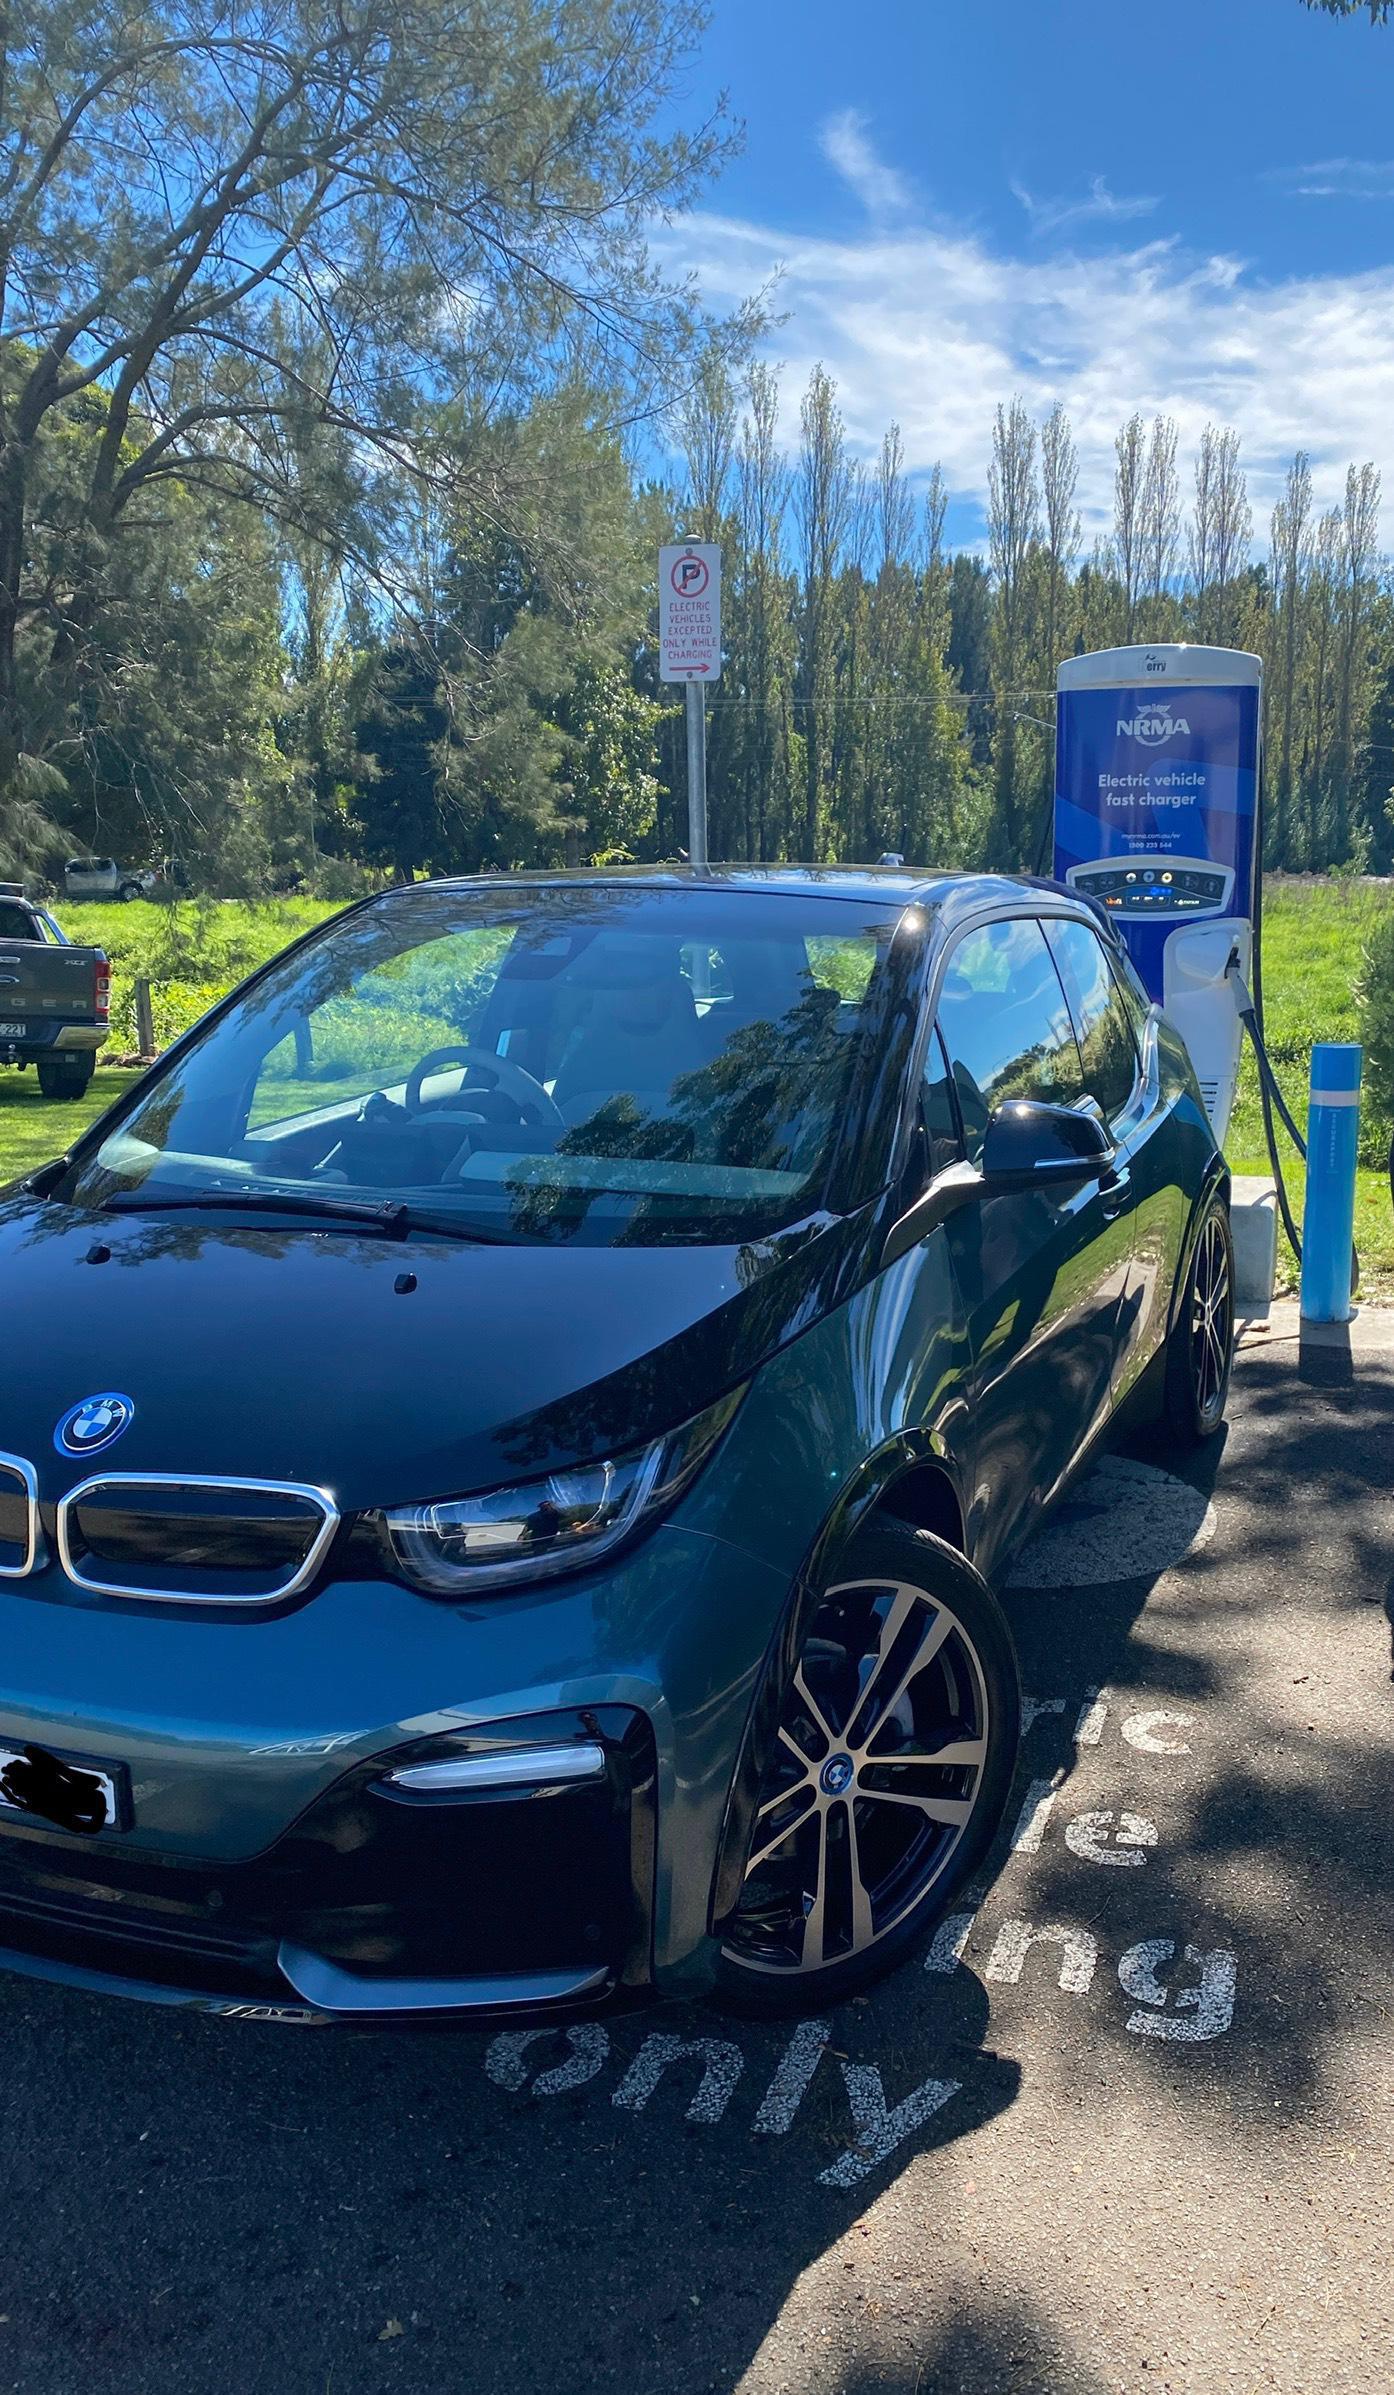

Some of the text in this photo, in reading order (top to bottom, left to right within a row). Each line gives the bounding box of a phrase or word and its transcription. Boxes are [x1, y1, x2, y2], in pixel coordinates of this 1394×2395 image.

[669, 601, 710, 612] ELECTRIC
[669, 614, 711, 624] VEHICLES
[668, 626, 712, 636] EXCEPTED
[662, 637, 717, 649] ONLY WHILE
[668, 650, 712, 660] CHARGING
[1116, 718, 1191, 736] NRMA
[1098, 772, 1206, 788] Electric vehicle
[1106, 792, 1197, 809] fast charger
[484, 2020, 964, 2188] only
